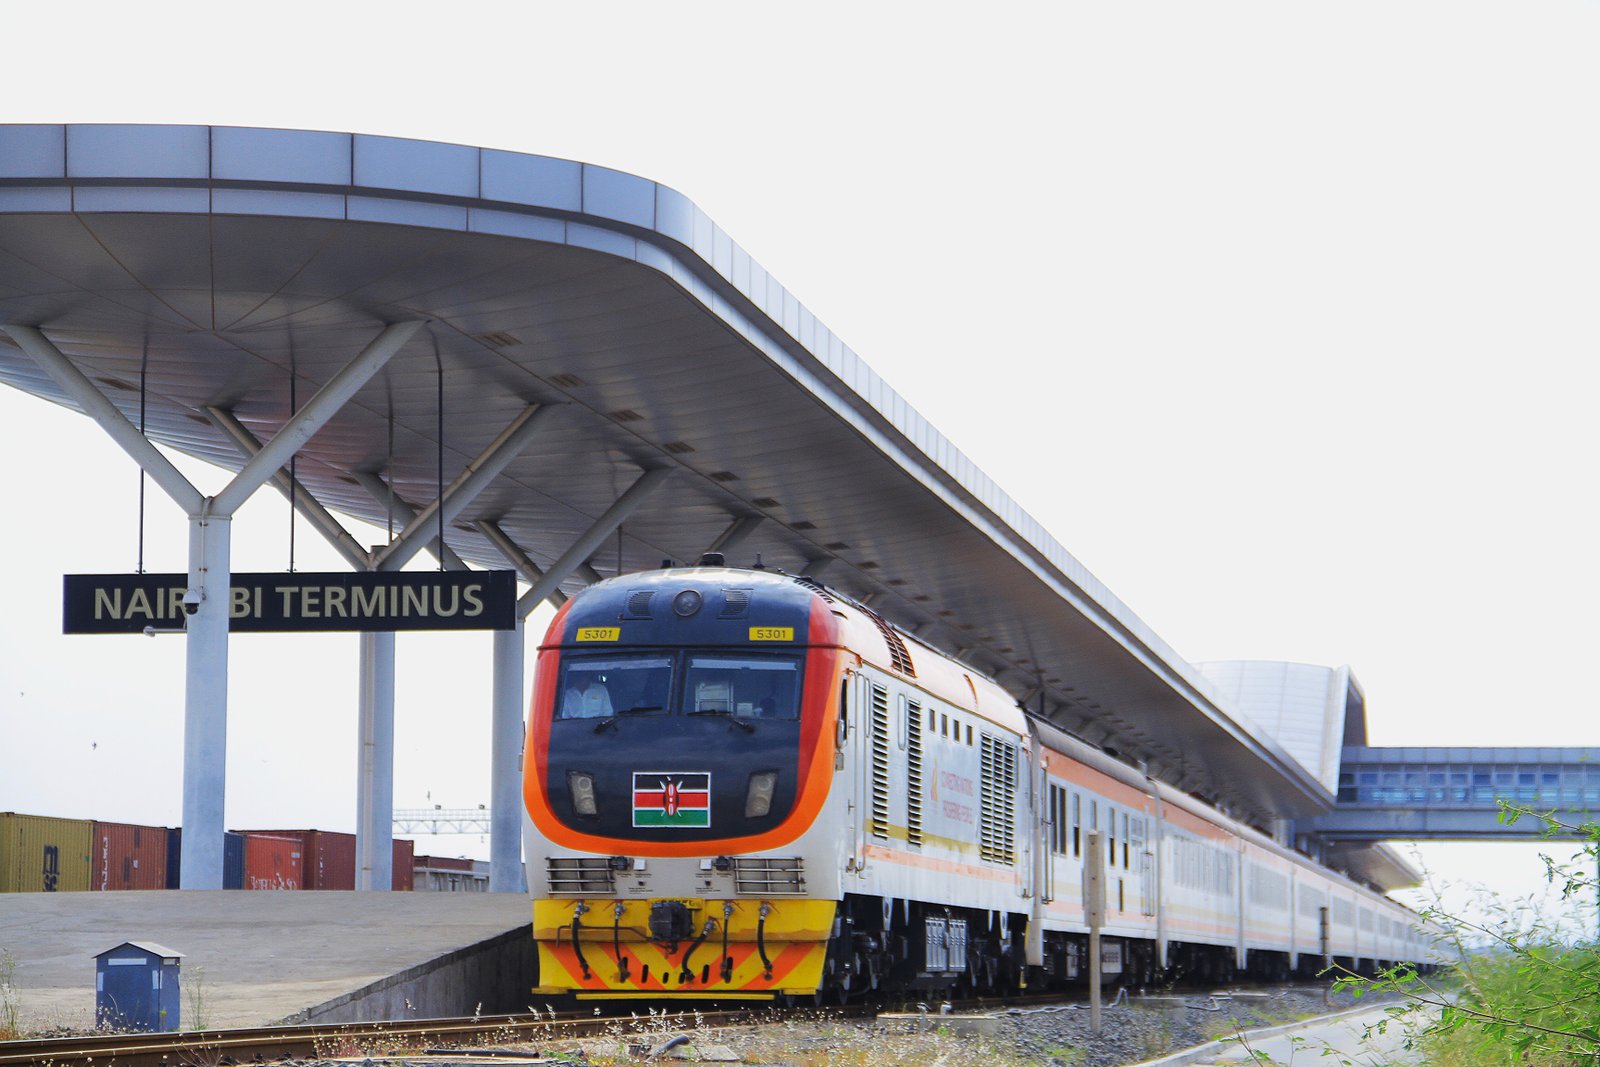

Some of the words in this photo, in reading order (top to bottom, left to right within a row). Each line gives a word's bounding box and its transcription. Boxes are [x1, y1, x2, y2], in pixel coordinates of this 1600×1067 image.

[94, 587, 262, 620] NAIRBI
[275, 584, 484, 618] TERMINUS
[584, 629, 613, 640] 5301
[756, 629, 786, 640] 5301
